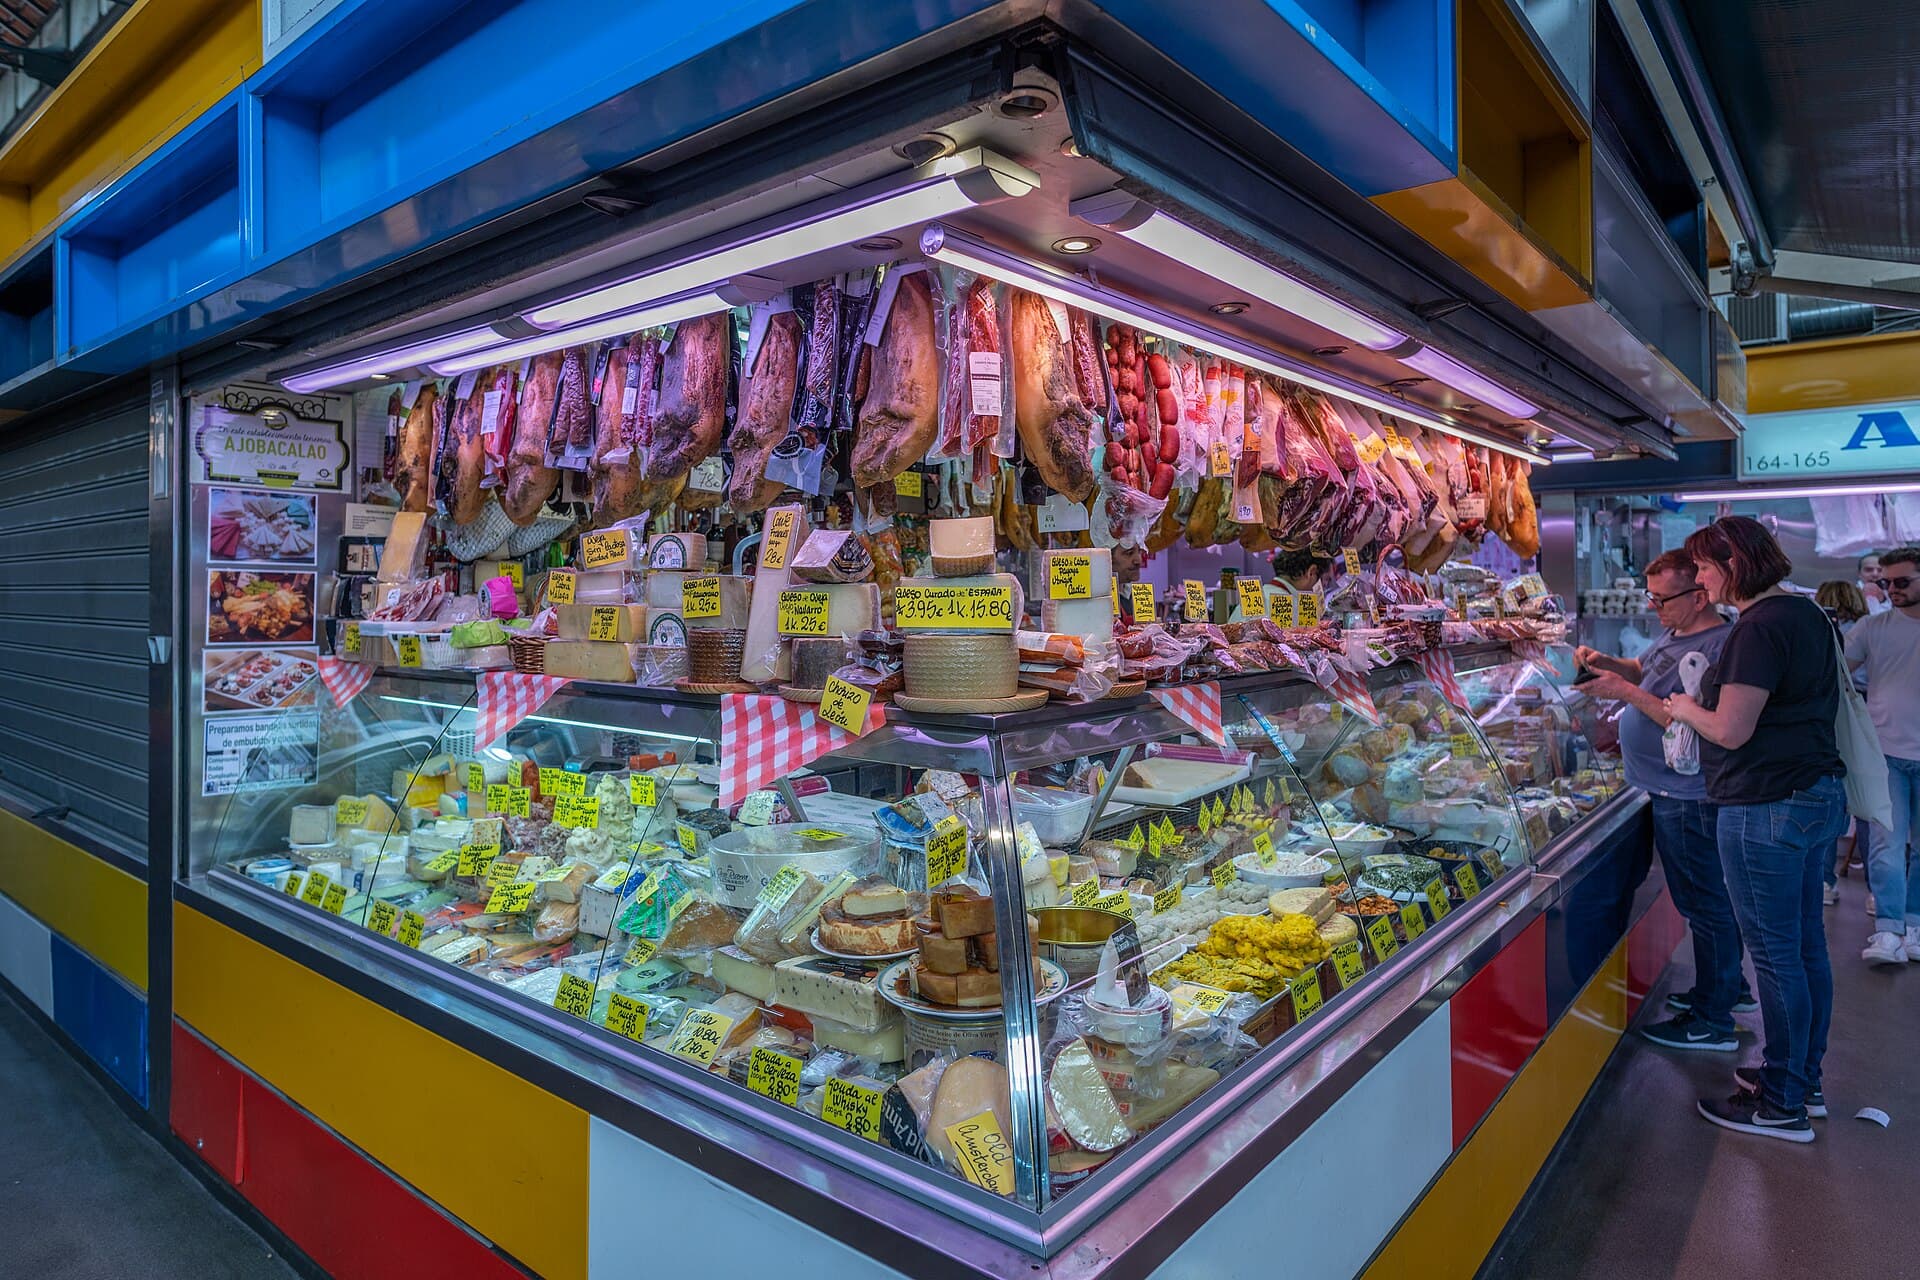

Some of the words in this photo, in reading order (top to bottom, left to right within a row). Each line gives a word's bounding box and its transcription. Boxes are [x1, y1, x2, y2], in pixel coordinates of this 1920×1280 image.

[1841, 411, 1920, 451] A
[224, 435, 327, 460] AJOBACALAO
[1746, 451, 1830, 471] 164-165
[832, 698, 844, 709] de
[208, 725, 254, 736] Preparamos
[222, 739, 232, 748] de
[983, 1132, 1012, 1166] Old
